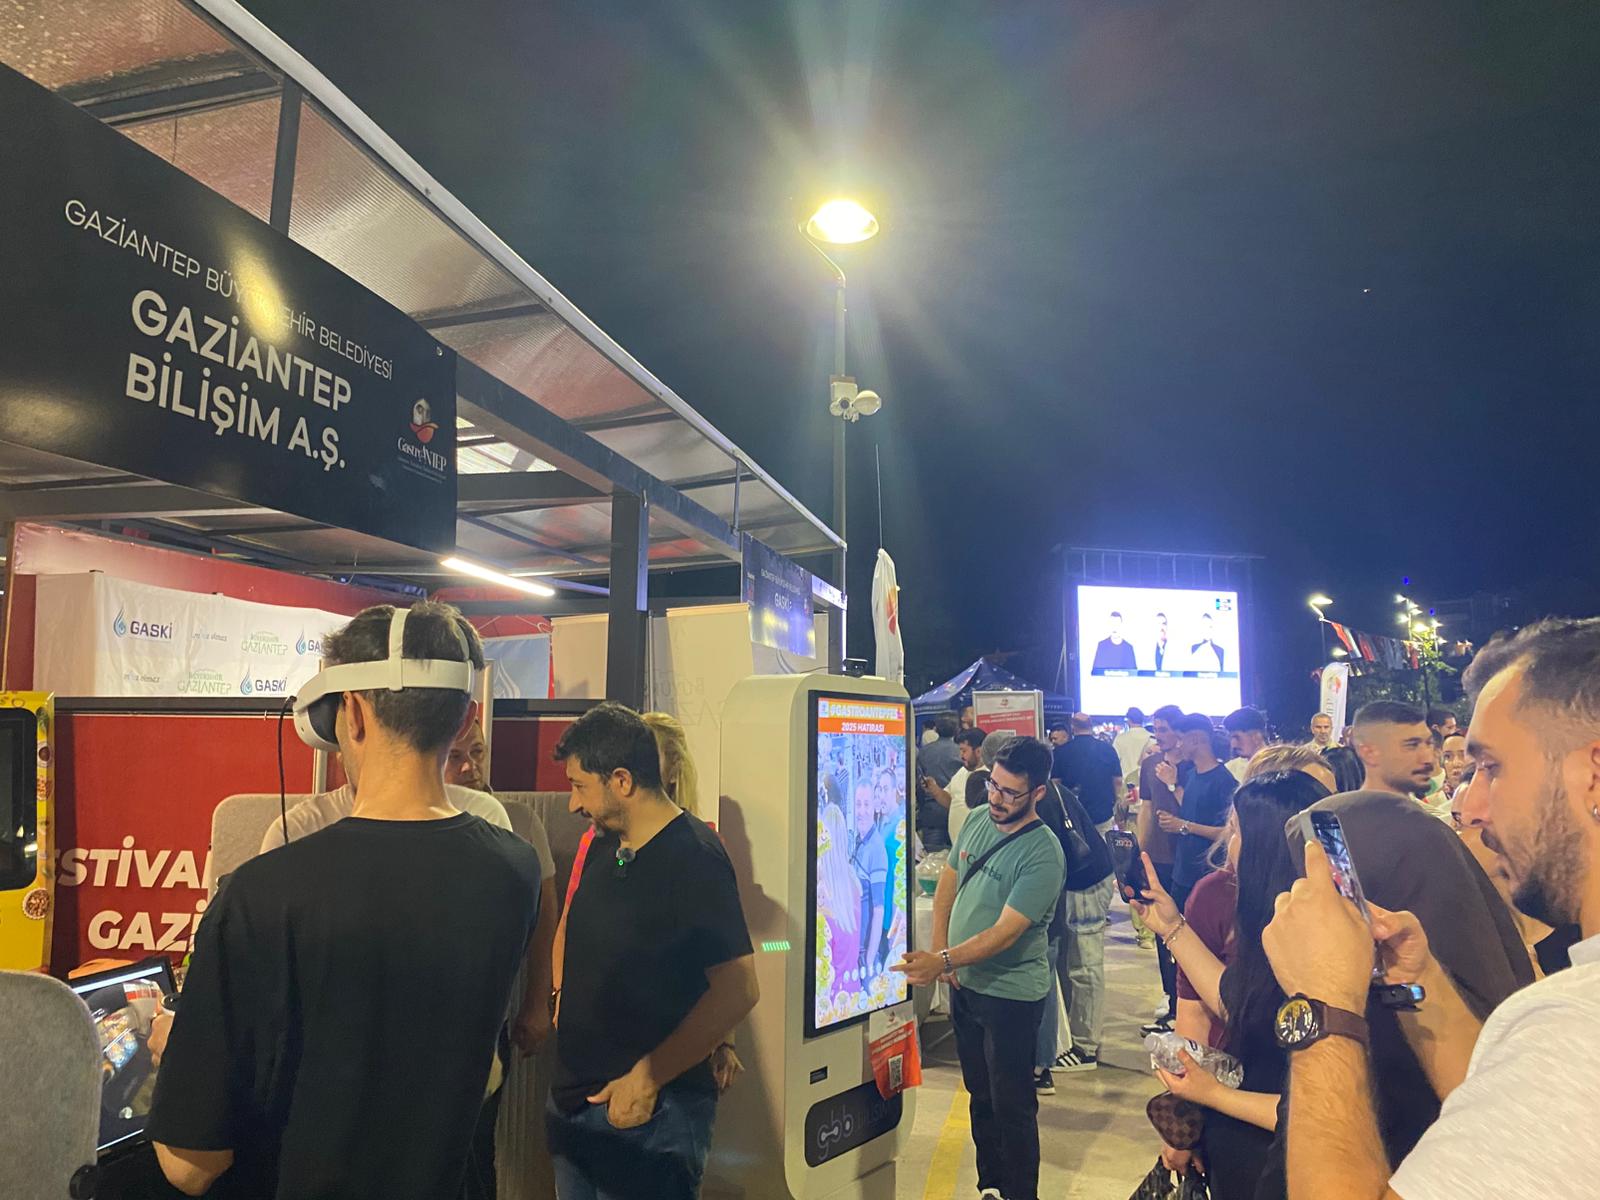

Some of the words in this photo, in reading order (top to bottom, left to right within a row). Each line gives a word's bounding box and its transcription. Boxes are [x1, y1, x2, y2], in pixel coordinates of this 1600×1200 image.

[65, 199, 200, 279] GAZİANTEP
[206, 267, 316, 340] BÜYEHİR
[319, 326, 393, 381] BELEDİYESİ
[131, 289, 351, 411] GAZİANTEP
[125, 352, 280, 445] BİLİŞİM
[287, 416, 346, 471] A.Ş.
[130, 620, 173, 639] GASKİ
[255, 676, 288, 692] GASKİ
[55, 834, 212, 889] STİVA
